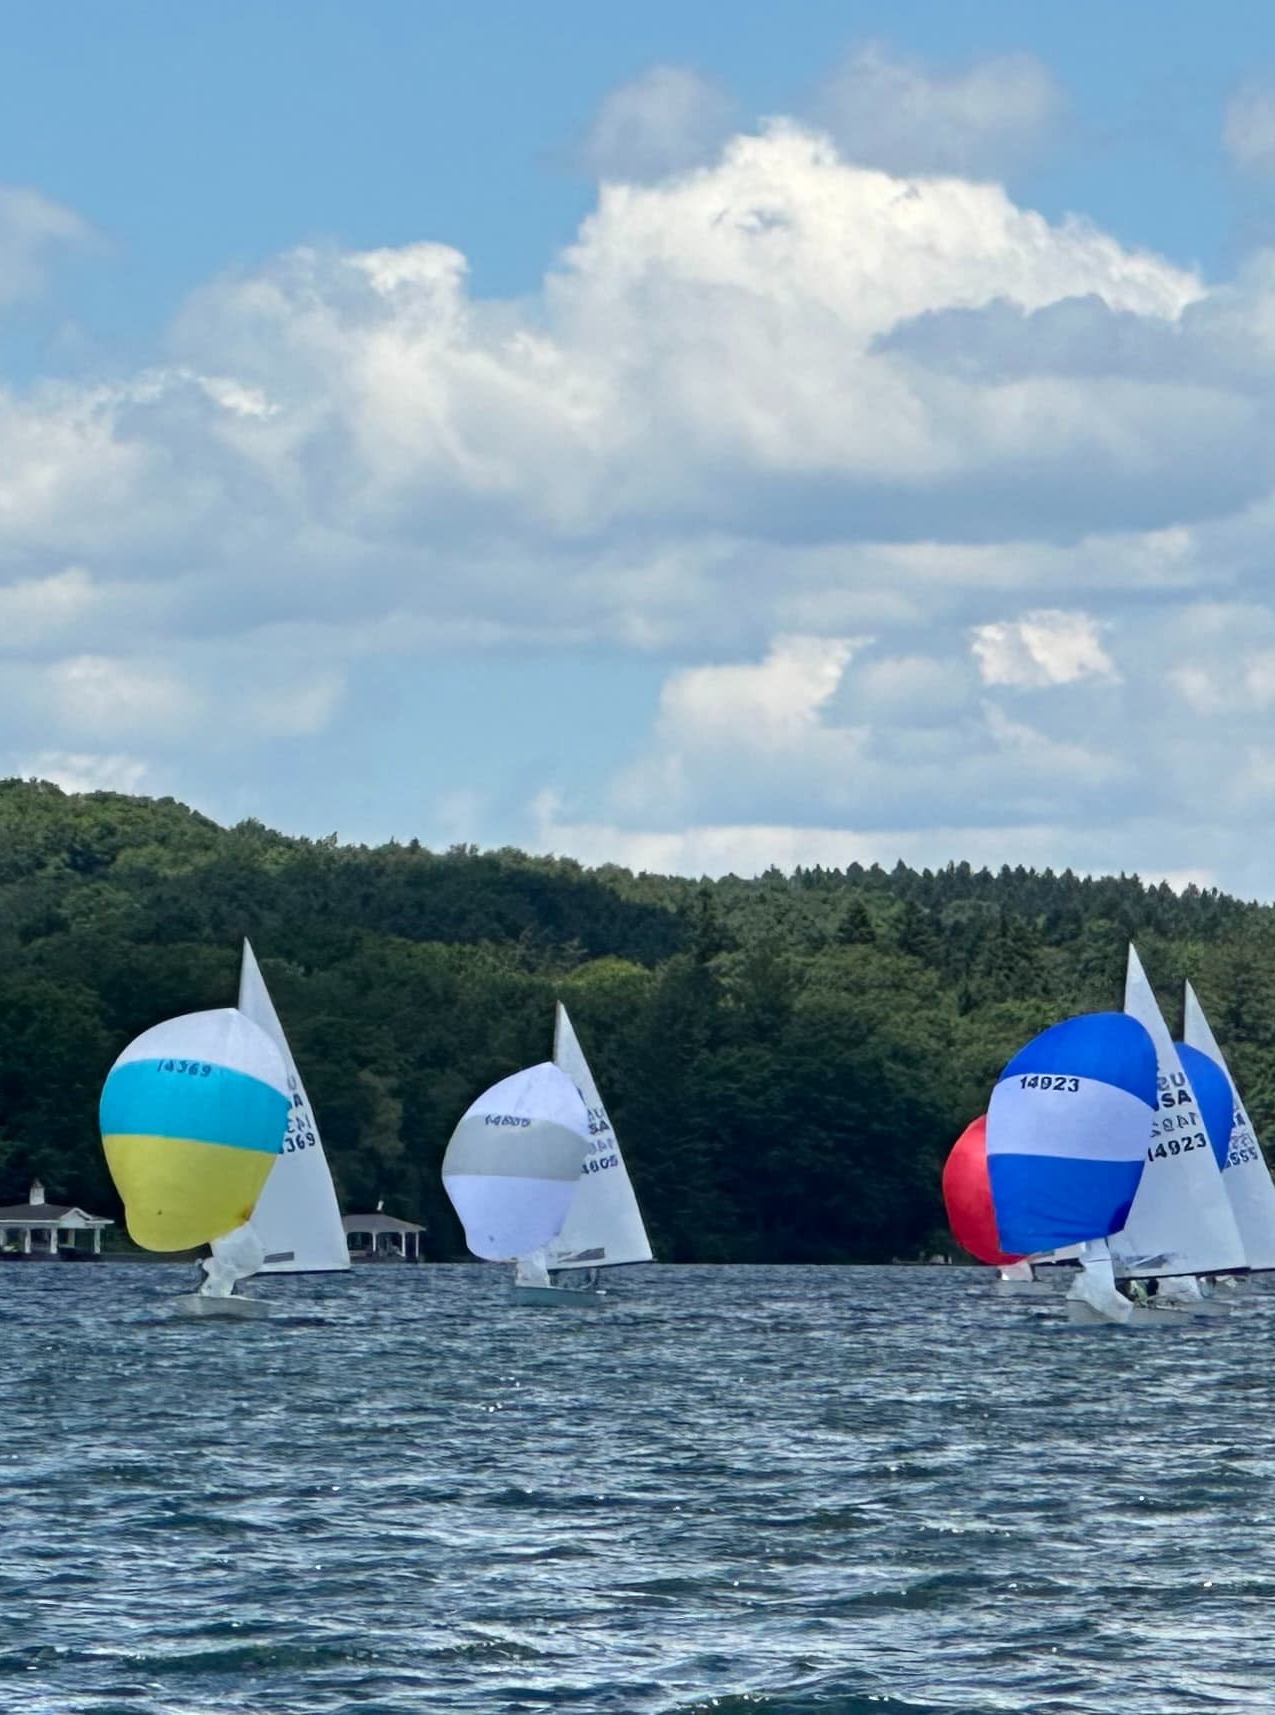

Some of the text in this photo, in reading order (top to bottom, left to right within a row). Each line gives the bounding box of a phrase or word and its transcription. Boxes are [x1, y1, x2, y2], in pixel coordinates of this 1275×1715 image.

[157, 1058, 212, 1078] 14369
[1020, 1075, 1080, 1093] 14923
[1161, 1089, 1192, 1108] SA
[282, 1132, 316, 1153] 369
[1148, 1132, 1207, 1162] 14923
